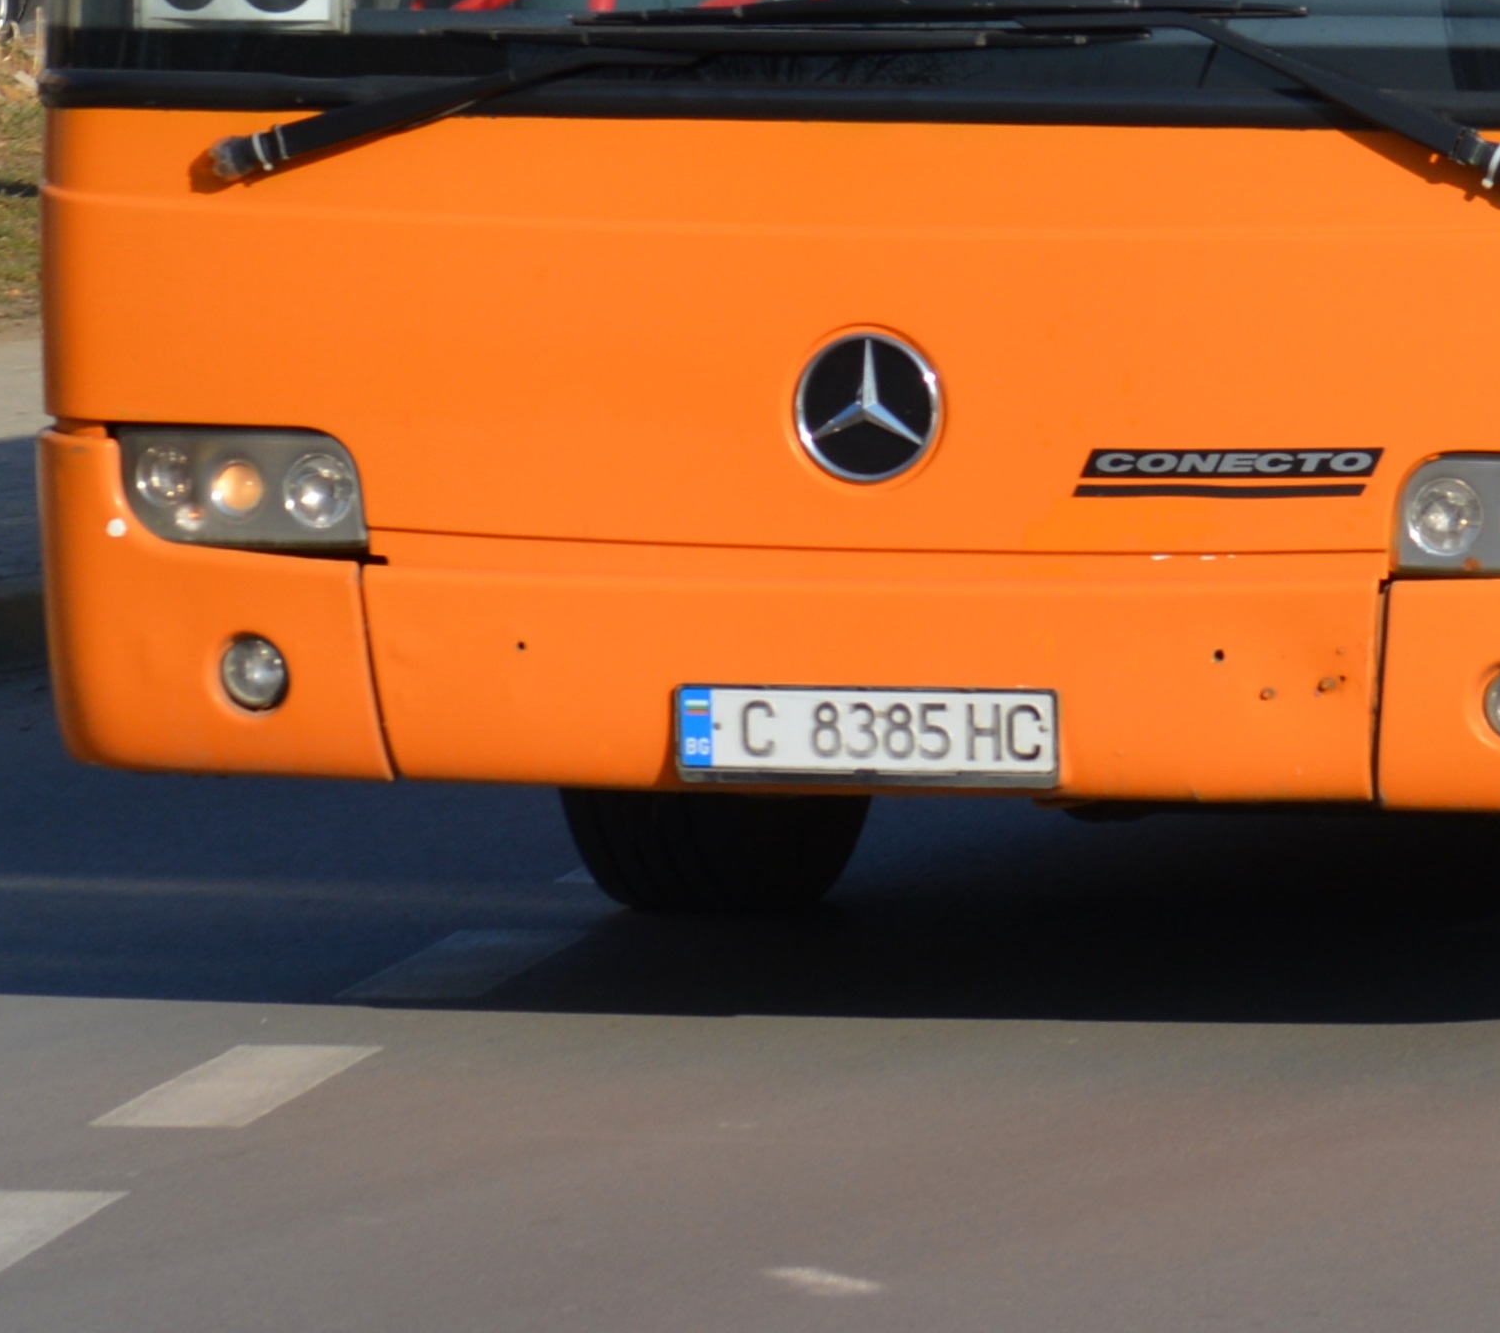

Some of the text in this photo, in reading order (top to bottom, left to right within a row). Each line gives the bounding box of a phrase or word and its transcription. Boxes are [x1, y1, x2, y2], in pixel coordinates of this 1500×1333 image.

[1095, 451, 1374, 474] CONECTO
[740, 700, 1042, 762] C 8385 HC
[685, 737, 711, 756] BG
